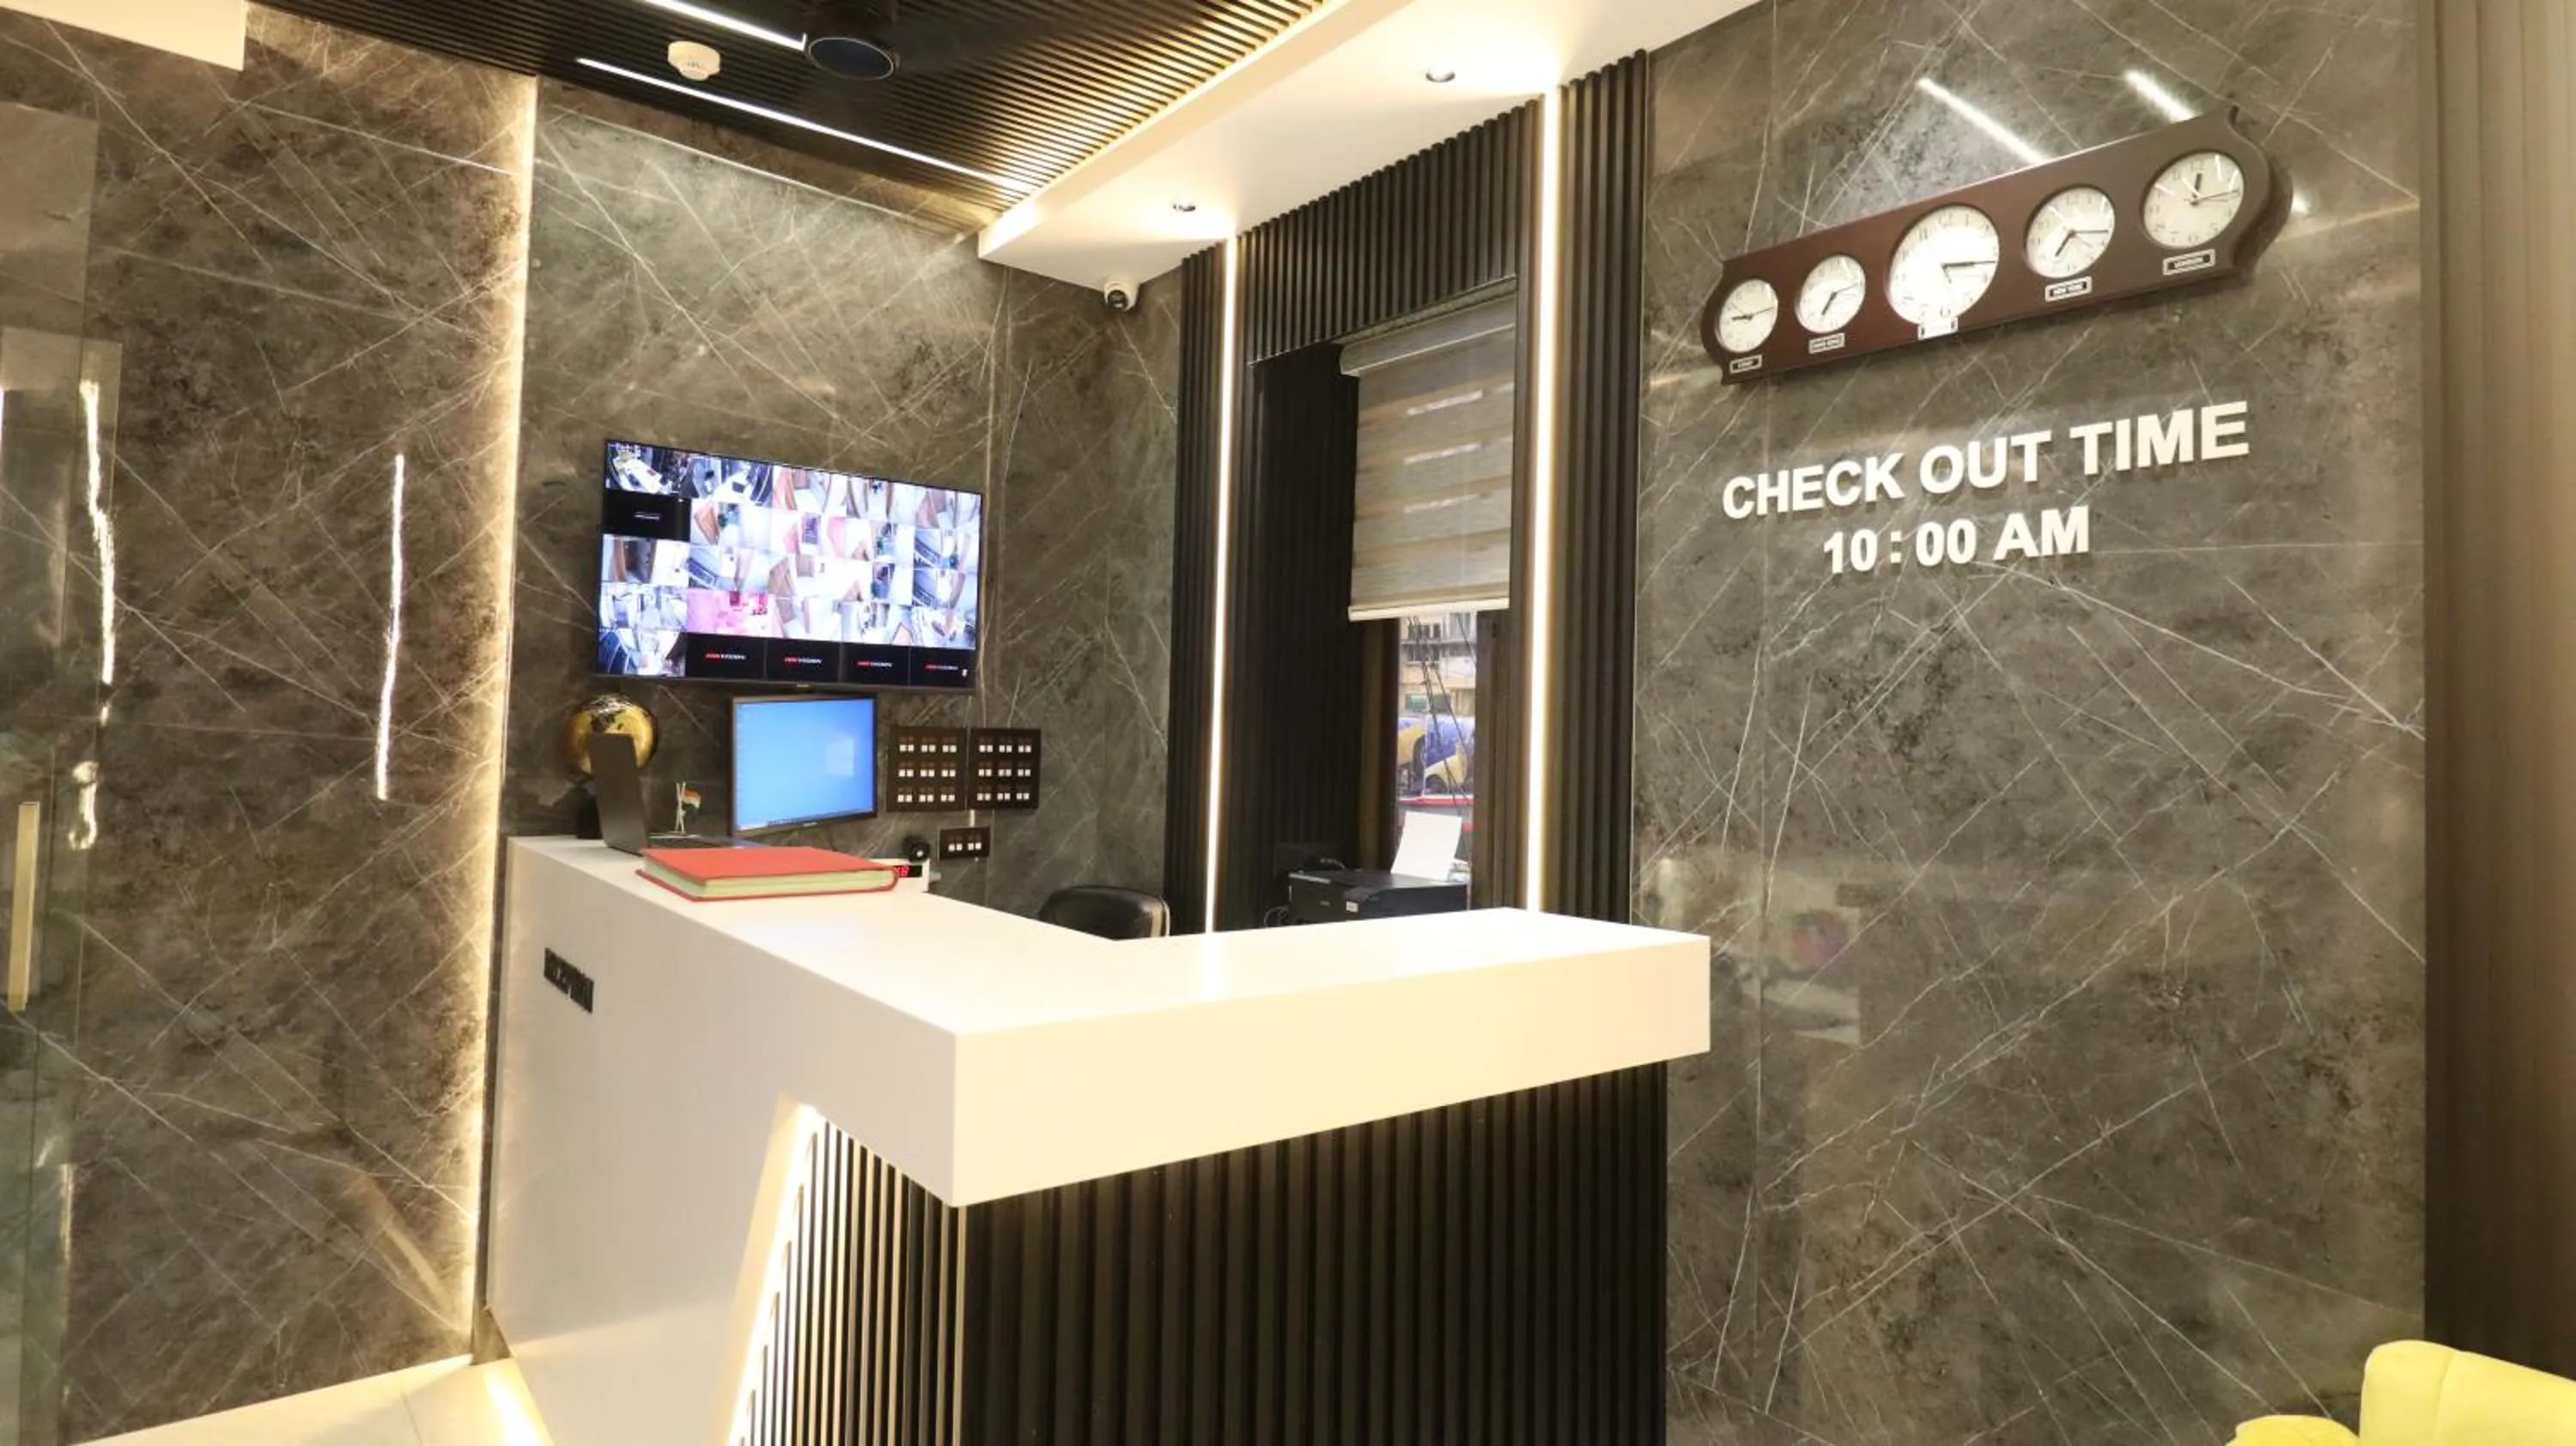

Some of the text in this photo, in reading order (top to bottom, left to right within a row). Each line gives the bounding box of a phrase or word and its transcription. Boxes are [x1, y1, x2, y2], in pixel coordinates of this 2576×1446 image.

[1722, 400, 2250, 519] CHECK OUT TIME
[1992, 505, 2090, 562] AM
